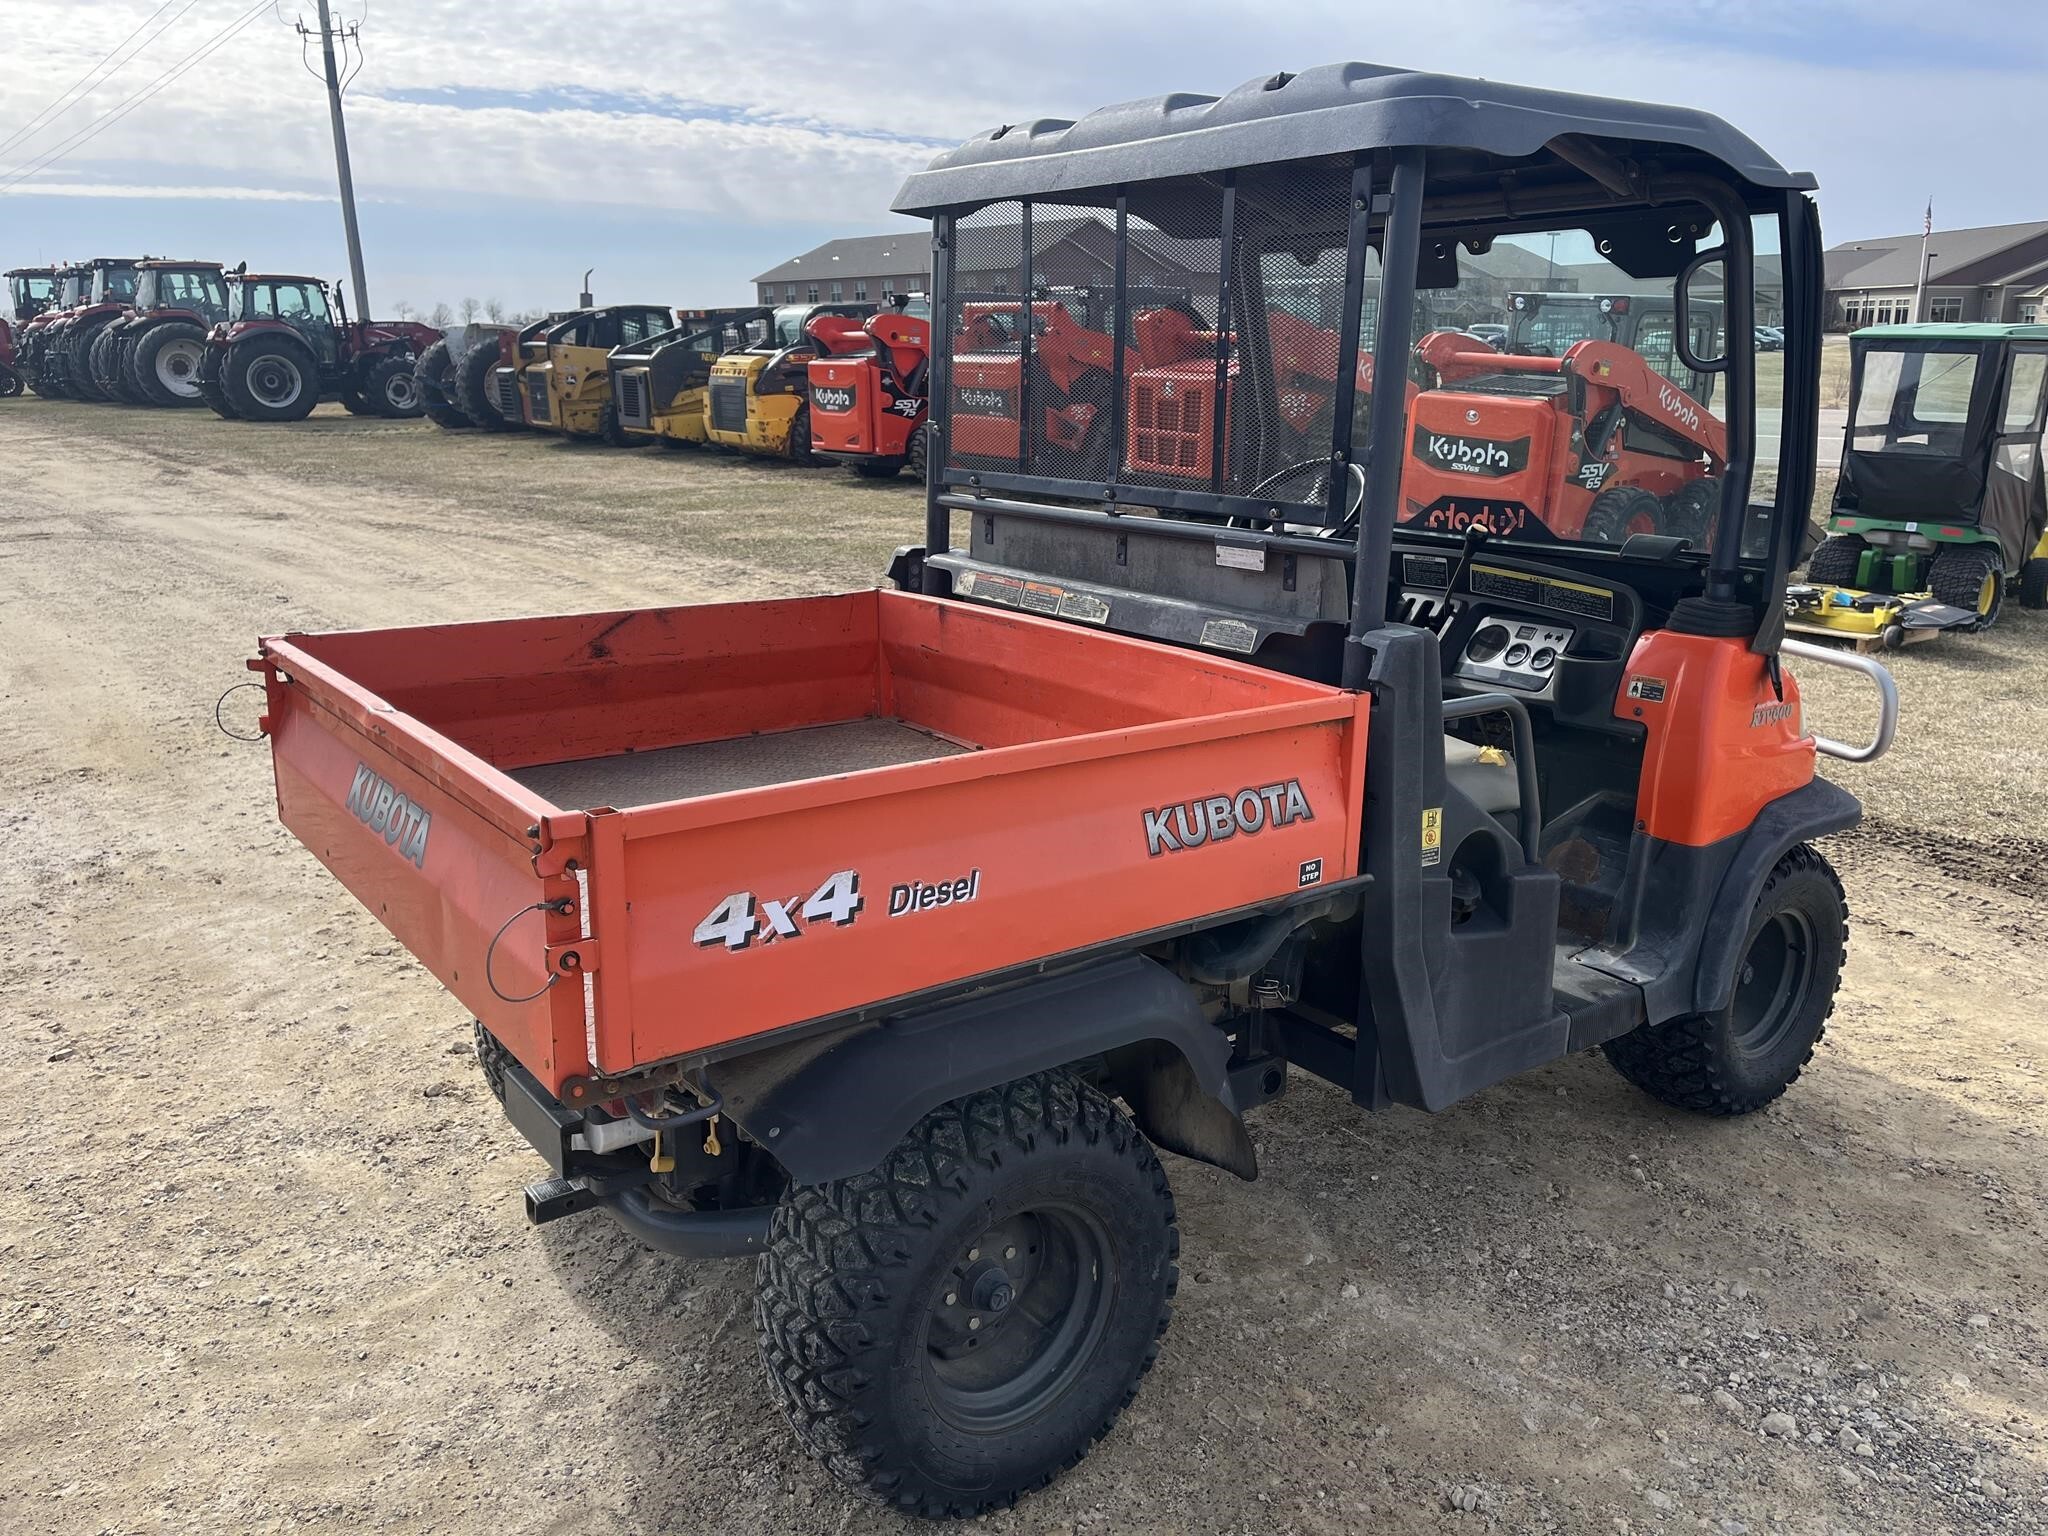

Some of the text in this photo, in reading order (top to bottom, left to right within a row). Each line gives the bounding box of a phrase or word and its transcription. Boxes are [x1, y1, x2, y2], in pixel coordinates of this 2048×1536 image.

[815, 388, 850, 405] Kubota
[894, 399, 921, 410] SSV
[1659, 384, 1699, 431] Kubota
[902, 408, 917, 417] 75
[1429, 436, 1509, 467] Kubota
[1451, 462, 1480, 473] SSV65
[1579, 463, 1609, 478] SSV
[1586, 477, 1602, 489] 65
[345, 761, 432, 869] KUBOTA
[1142, 779, 1314, 856] KUBOTA
[1305, 863, 1316, 872] NO
[1301, 870, 1319, 883] STEP
[693, 867, 980, 952] 4x4 Diesel
